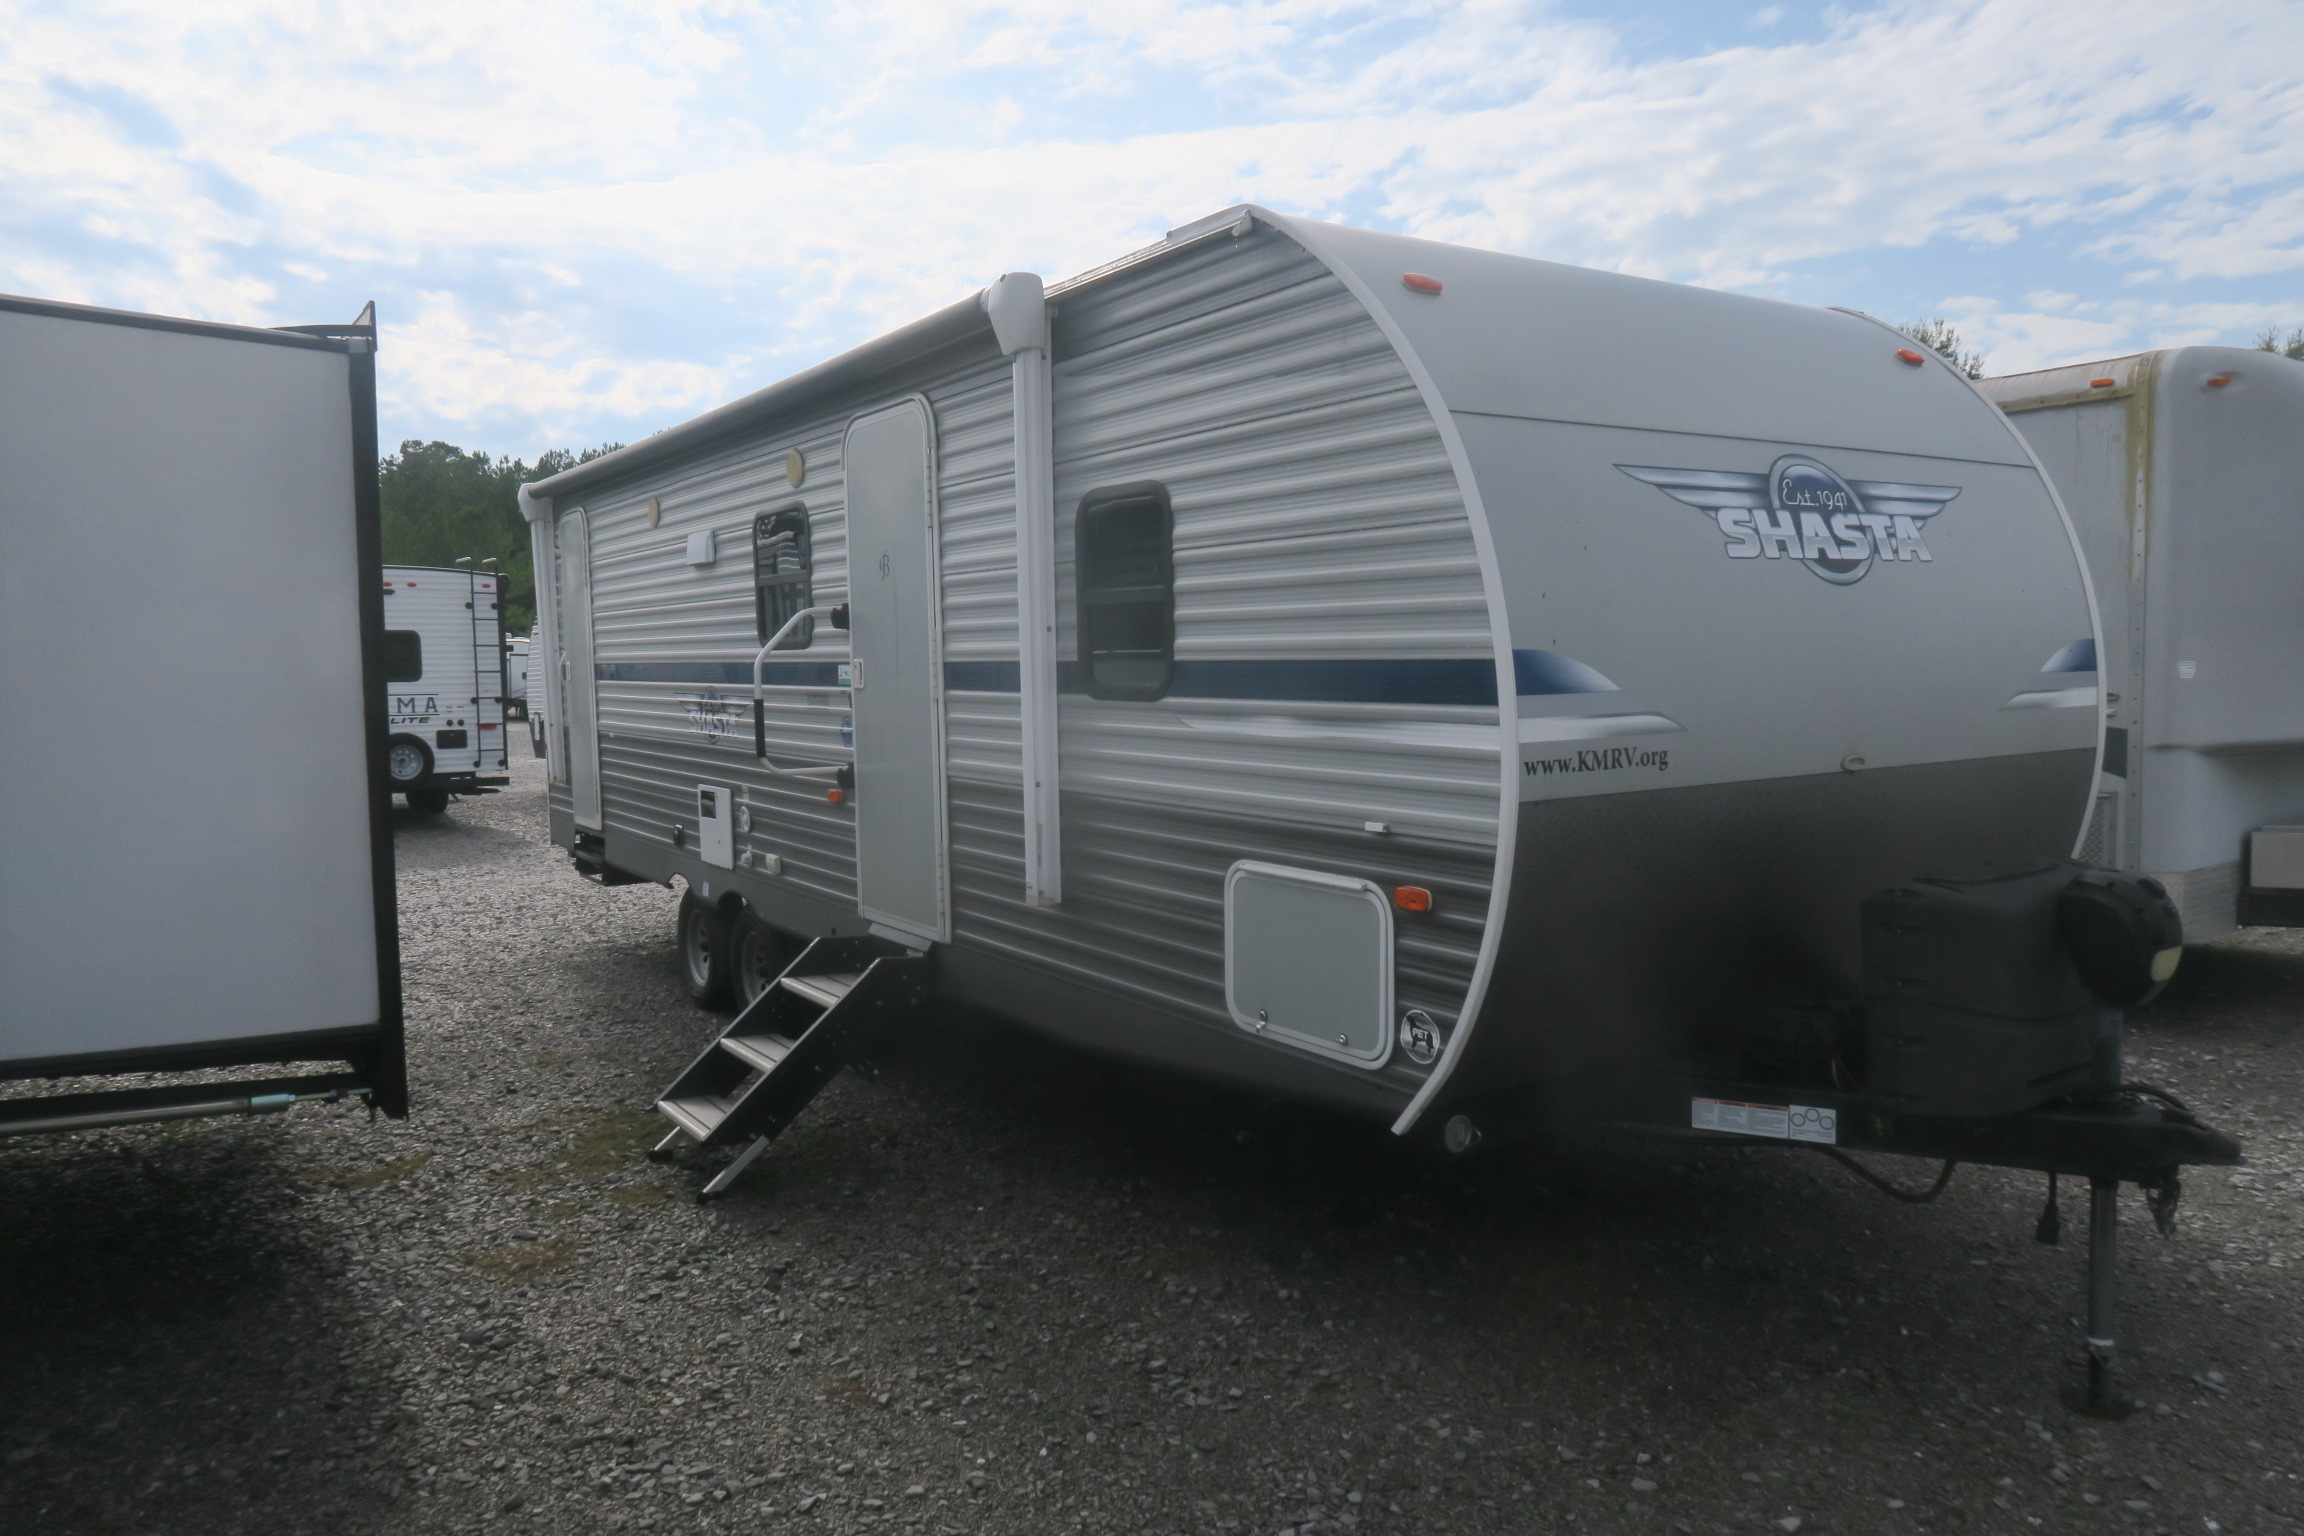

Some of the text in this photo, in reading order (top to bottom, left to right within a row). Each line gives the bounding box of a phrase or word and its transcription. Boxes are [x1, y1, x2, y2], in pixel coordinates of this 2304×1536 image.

[1716, 506, 1933, 562] SHASTA
[396, 696, 439, 713] MA
[390, 716, 431, 724] LITE
[1523, 747, 1669, 777] www.KMRV.org
[1411, 1027, 1429, 1040] PET
